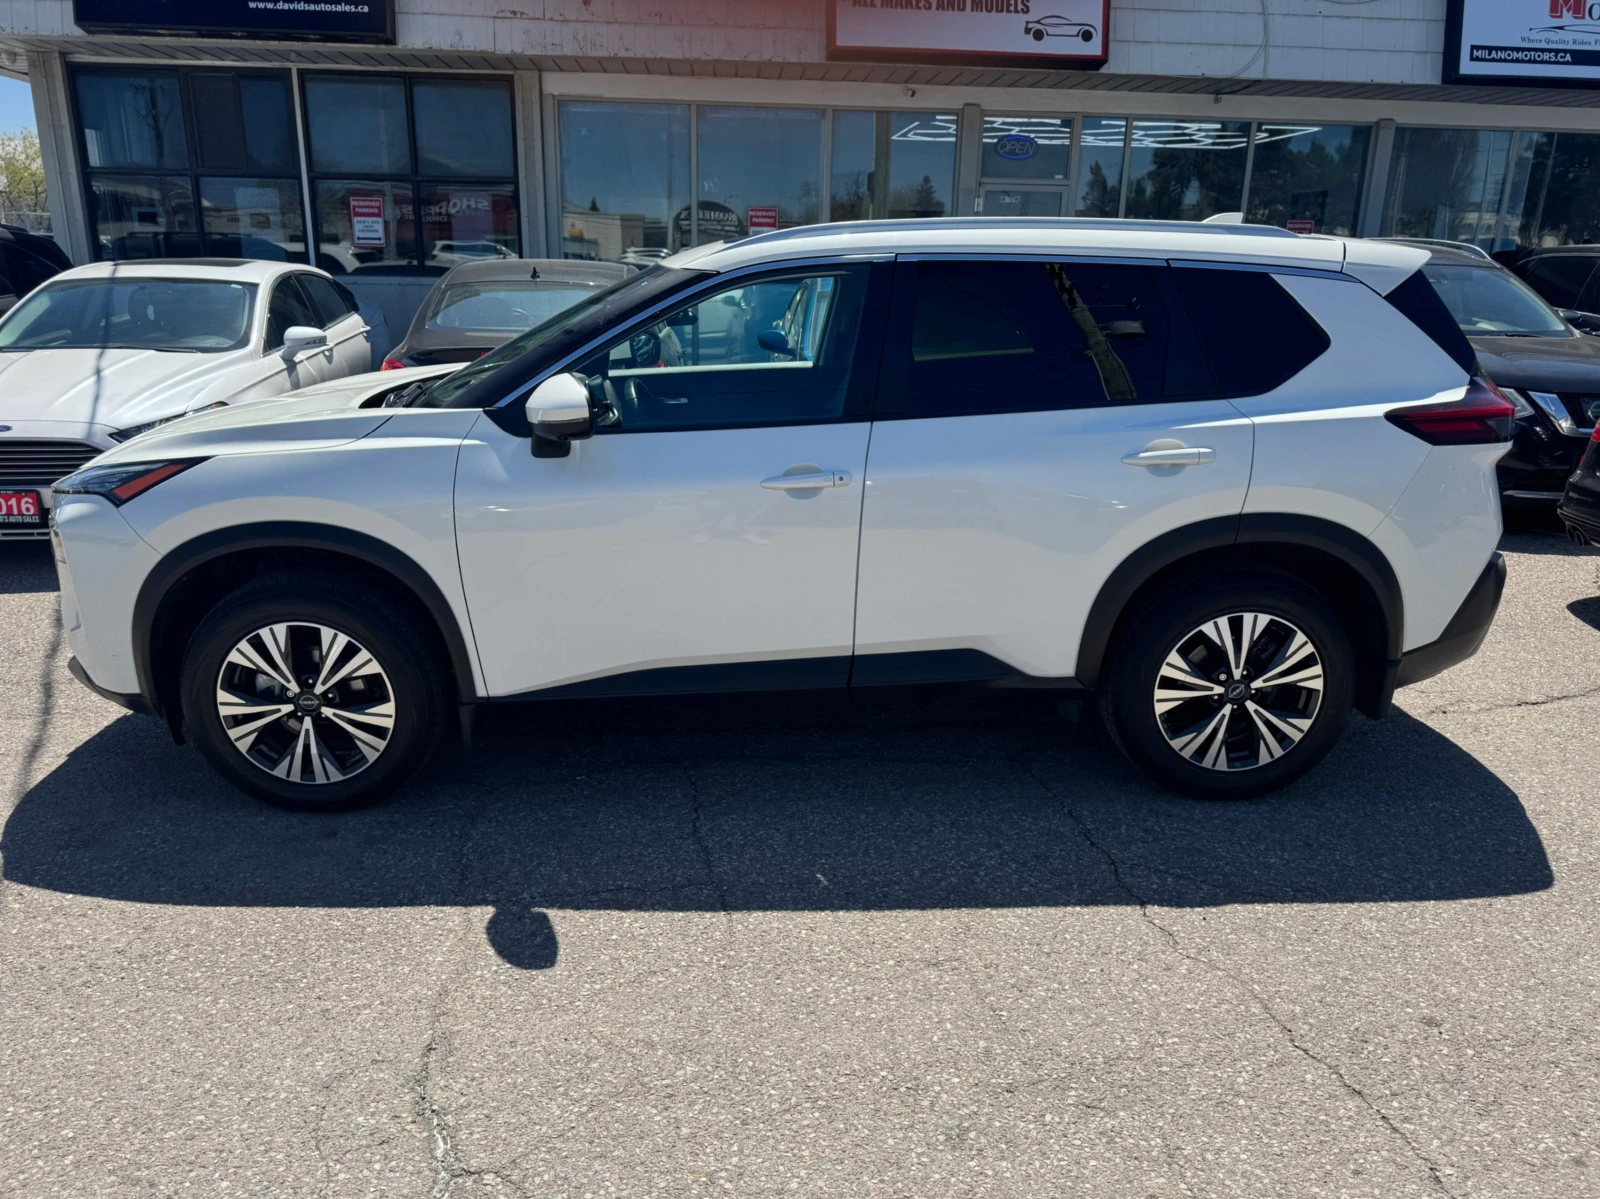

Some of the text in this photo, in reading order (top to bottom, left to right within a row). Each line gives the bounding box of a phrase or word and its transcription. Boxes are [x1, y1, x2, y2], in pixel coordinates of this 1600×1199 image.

[248, 1, 369, 12] www.davidsautosales.ca
[880, 0, 932, 11] MAKES
[935, 0, 966, 12] AND
[970, 0, 1030, 14] MODELS
[1520, 36, 1543, 44] Where
[1544, 37, 1570, 46] Quality
[1473, 49, 1572, 62] MILANOMOTORS.CA
[997, 141, 1036, 154] OPEN
